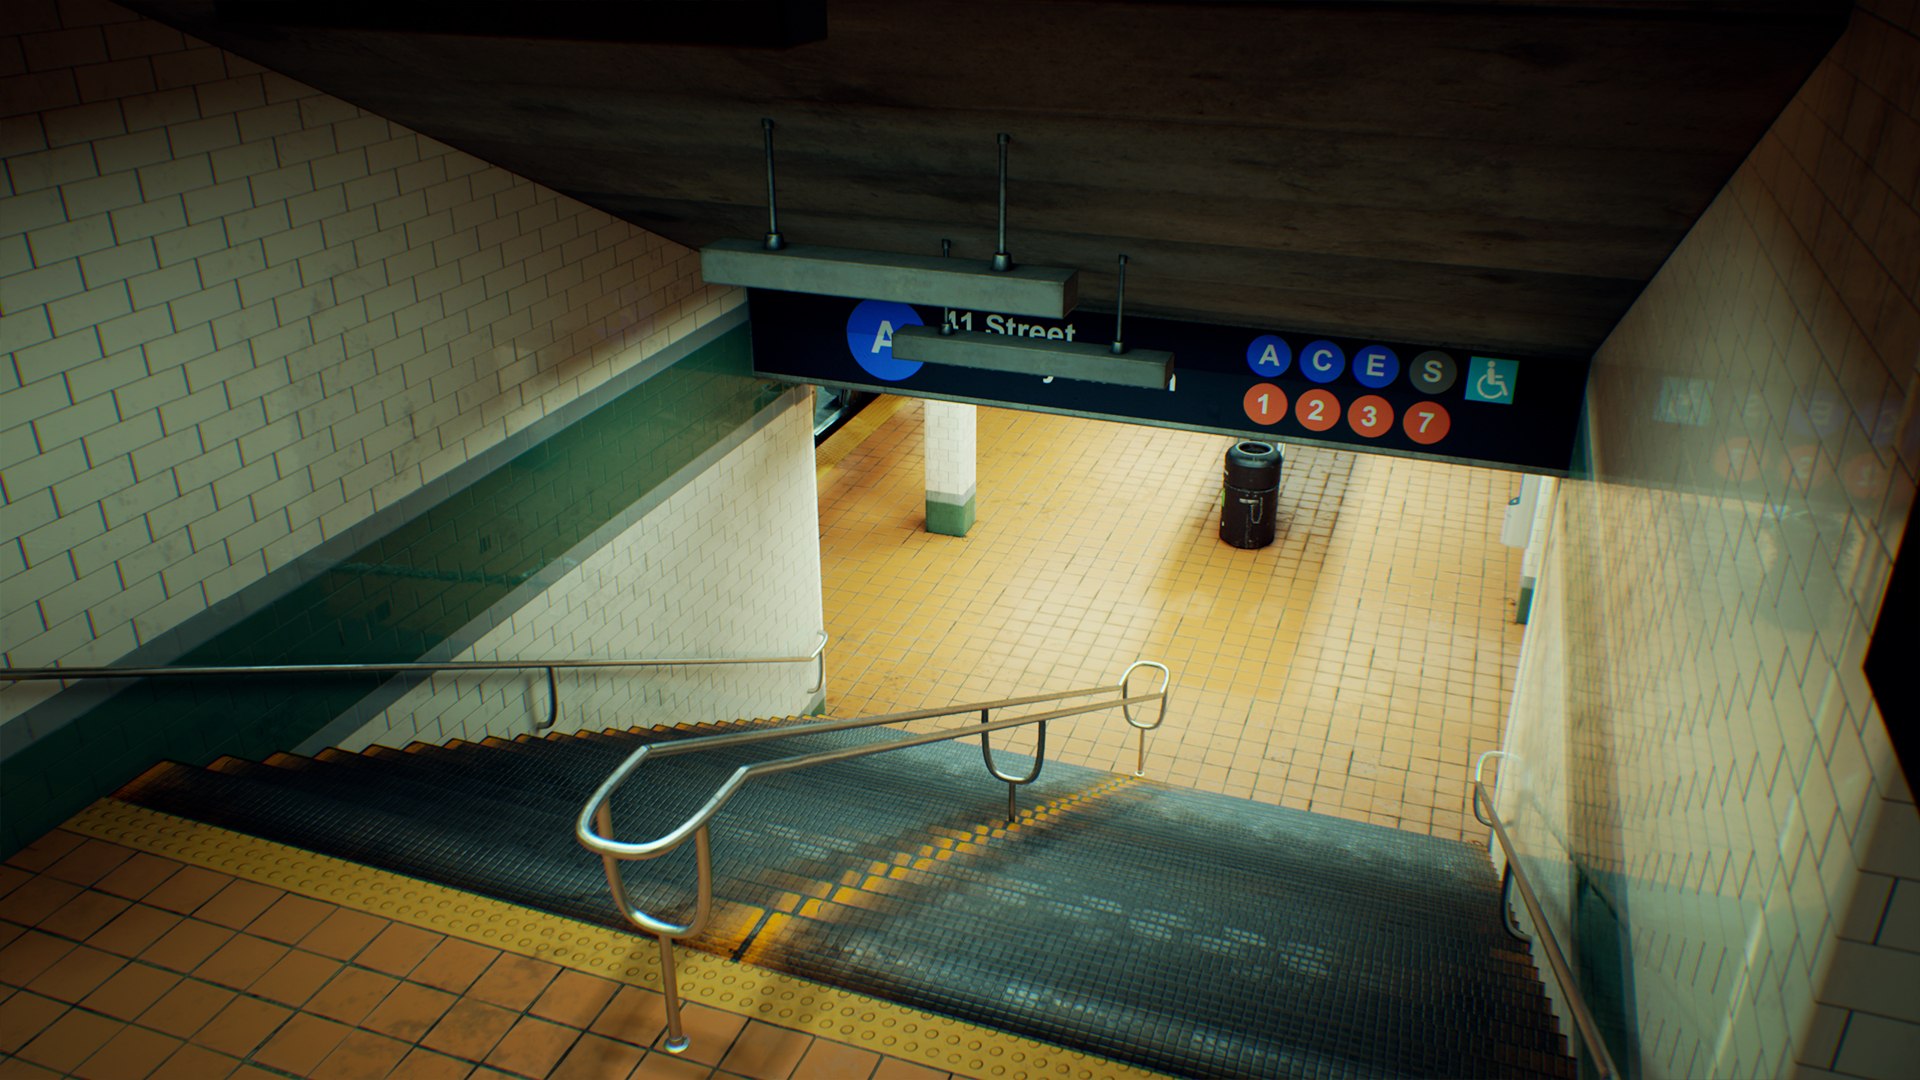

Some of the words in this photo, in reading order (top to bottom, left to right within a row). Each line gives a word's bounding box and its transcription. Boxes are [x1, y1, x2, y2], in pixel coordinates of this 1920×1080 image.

[871, 320, 894, 353] A
[986, 314, 1076, 342] Street
[1258, 345, 1280, 366] A
[1313, 350, 1332, 371] C
[1366, 355, 1386, 376] E
[1422, 361, 1442, 382] S
[1257, 394, 1268, 414] 1
[1307, 400, 1323, 420] 2
[1361, 406, 1377, 427] 3
[1418, 412, 1434, 433] 7
